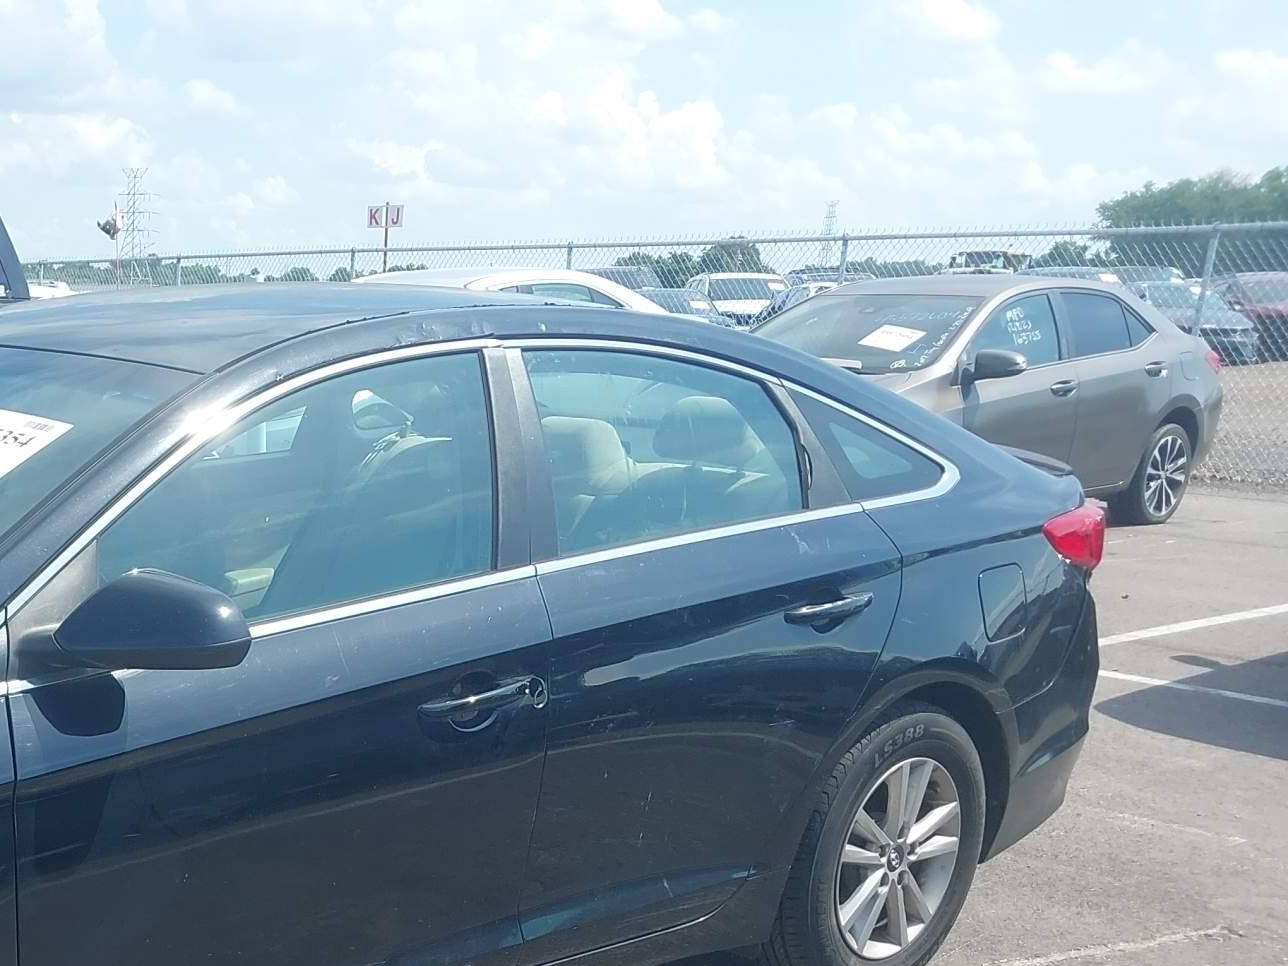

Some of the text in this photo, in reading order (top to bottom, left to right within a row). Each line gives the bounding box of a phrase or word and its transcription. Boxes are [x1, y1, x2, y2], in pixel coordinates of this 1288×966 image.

[369, 207, 400, 225] K J
[873, 723, 926, 769] LS388
